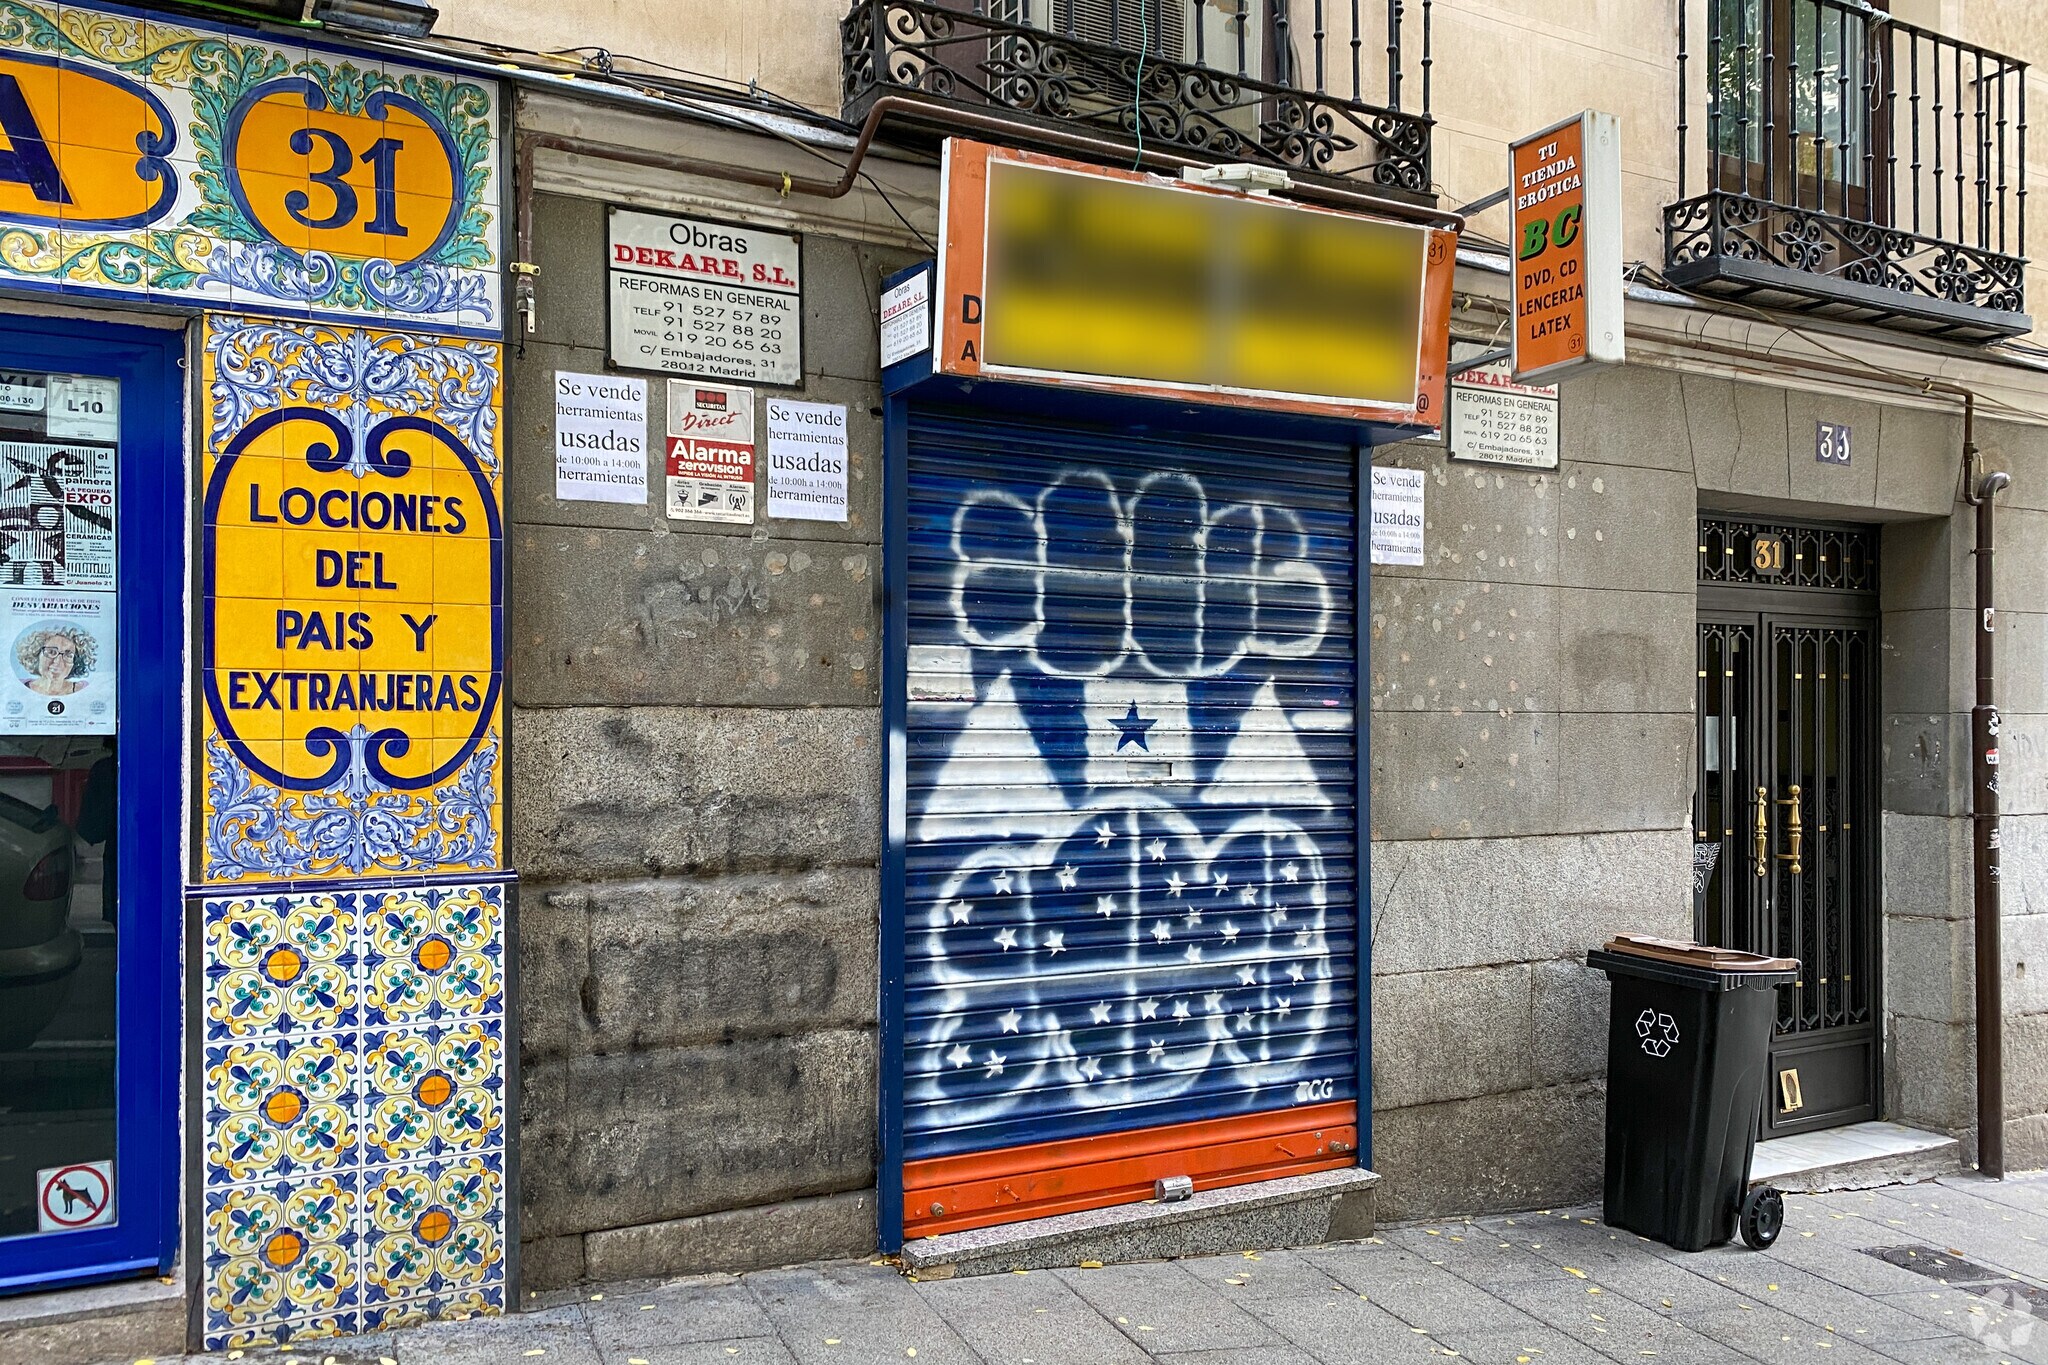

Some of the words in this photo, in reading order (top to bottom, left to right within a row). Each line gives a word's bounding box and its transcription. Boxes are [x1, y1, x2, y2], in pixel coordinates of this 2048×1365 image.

[1538, 141, 1558, 161] TU
[1521, 156, 1577, 189] TIENDA
[284, 128, 408, 238] 31
[1517, 173, 1582, 211] ERÓTICA
[670, 223, 748, 254] Obras
[1519, 203, 1583, 261] BC
[1428, 242, 1443, 260] 31
[614, 244, 746, 283] DEKARE,
[752, 263, 796, 287] S.L.
[1524, 267, 1555, 290] DVD,
[1559, 259, 1577, 278] CD
[619, 277, 700, 299] REFORMAS
[704, 289, 723, 301] EN
[727, 292, 791, 311] GENERAL
[894, 284, 910, 299] Obras
[1519, 284, 1584, 318] LENCERIA
[633, 306, 661, 317] TELF
[663, 301, 684, 313] 91
[692, 305, 726, 319] 527
[732, 310, 753, 322] 57
[760, 314, 781, 326] 89
[663, 316, 684, 328] 91
[692, 320, 726, 333] 527
[732, 325, 754, 337] 88
[760, 328, 782, 340] 20
[1531, 314, 1571, 339] LATEX
[633, 328, 658, 337] MOVIL
[664, 331, 698, 343] 619
[704, 336, 727, 348] 20
[732, 339, 754, 351] 65
[760, 343, 782, 354] 63
[1570, 336, 1582, 350] 31
[640, 345, 658, 356] C/
[661, 347, 756, 367] Embajadores,
[760, 359, 776, 369] 31
[661, 360, 705, 373] 28012
[709, 365, 756, 378] Madrid
[558, 378, 581, 396] Se
[587, 384, 642, 402] vende
[68, 400, 103, 414] L10
[557, 402, 643, 422] herramientas
[1456, 392, 1502, 406] REFORMAS
[1504, 398, 1515, 407] EN
[1517, 400, 1553, 412] GENERAL
[682, 411, 743, 431] Direct
[770, 405, 790, 422] Se
[795, 411, 842, 427] vende
[1481, 409, 1492, 417] 91
[1497, 411, 1516, 420] 527
[1519, 413, 1531, 422] 57
[1535, 416, 1548, 424] 89
[1481, 420, 1492, 428] 91
[1497, 422, 1516, 430] 527
[1519, 424, 1532, 432] 88
[559, 429, 640, 453] usadas
[769, 427, 844, 446] herramientas
[1481, 431, 1500, 440] 619
[1504, 434, 1517, 442] 20
[1535, 438, 1548, 446] 63
[670, 439, 751, 465] Alarma
[1479, 443, 1533, 456] Embajadores,
[1479, 452, 1503, 461] 28012
[1506, 455, 1533, 464] Madrid
[556, 455, 567, 464] de
[571, 456, 601, 467] 10:00h
[612, 459, 641, 470] 14:00h
[678, 461, 743, 475] zerovision
[772, 452, 842, 474] usadas
[65, 477, 112, 485] palmera
[558, 467, 645, 485] herramientas
[768, 476, 778, 484] de
[781, 477, 807, 487] 10:00h
[816, 479, 842, 490] 14:00h
[1373, 472, 1387, 486] Se
[1390, 475, 1421, 489] vende
[66, 493, 112, 505] EXPO
[770, 487, 845, 505] herramientas
[1372, 490, 1422, 503] herramientas
[250, 483, 467, 534] LOCIONES
[1374, 509, 1421, 527] usadas
[1371, 540, 1421, 554] herramientas
[1754, 540, 1782, 570] 31
[316, 549, 398, 590] DEL
[276, 609, 374, 651] PAIS
[401, 614, 439, 652] Y
[229, 671, 482, 712] EXTRANJERAS
